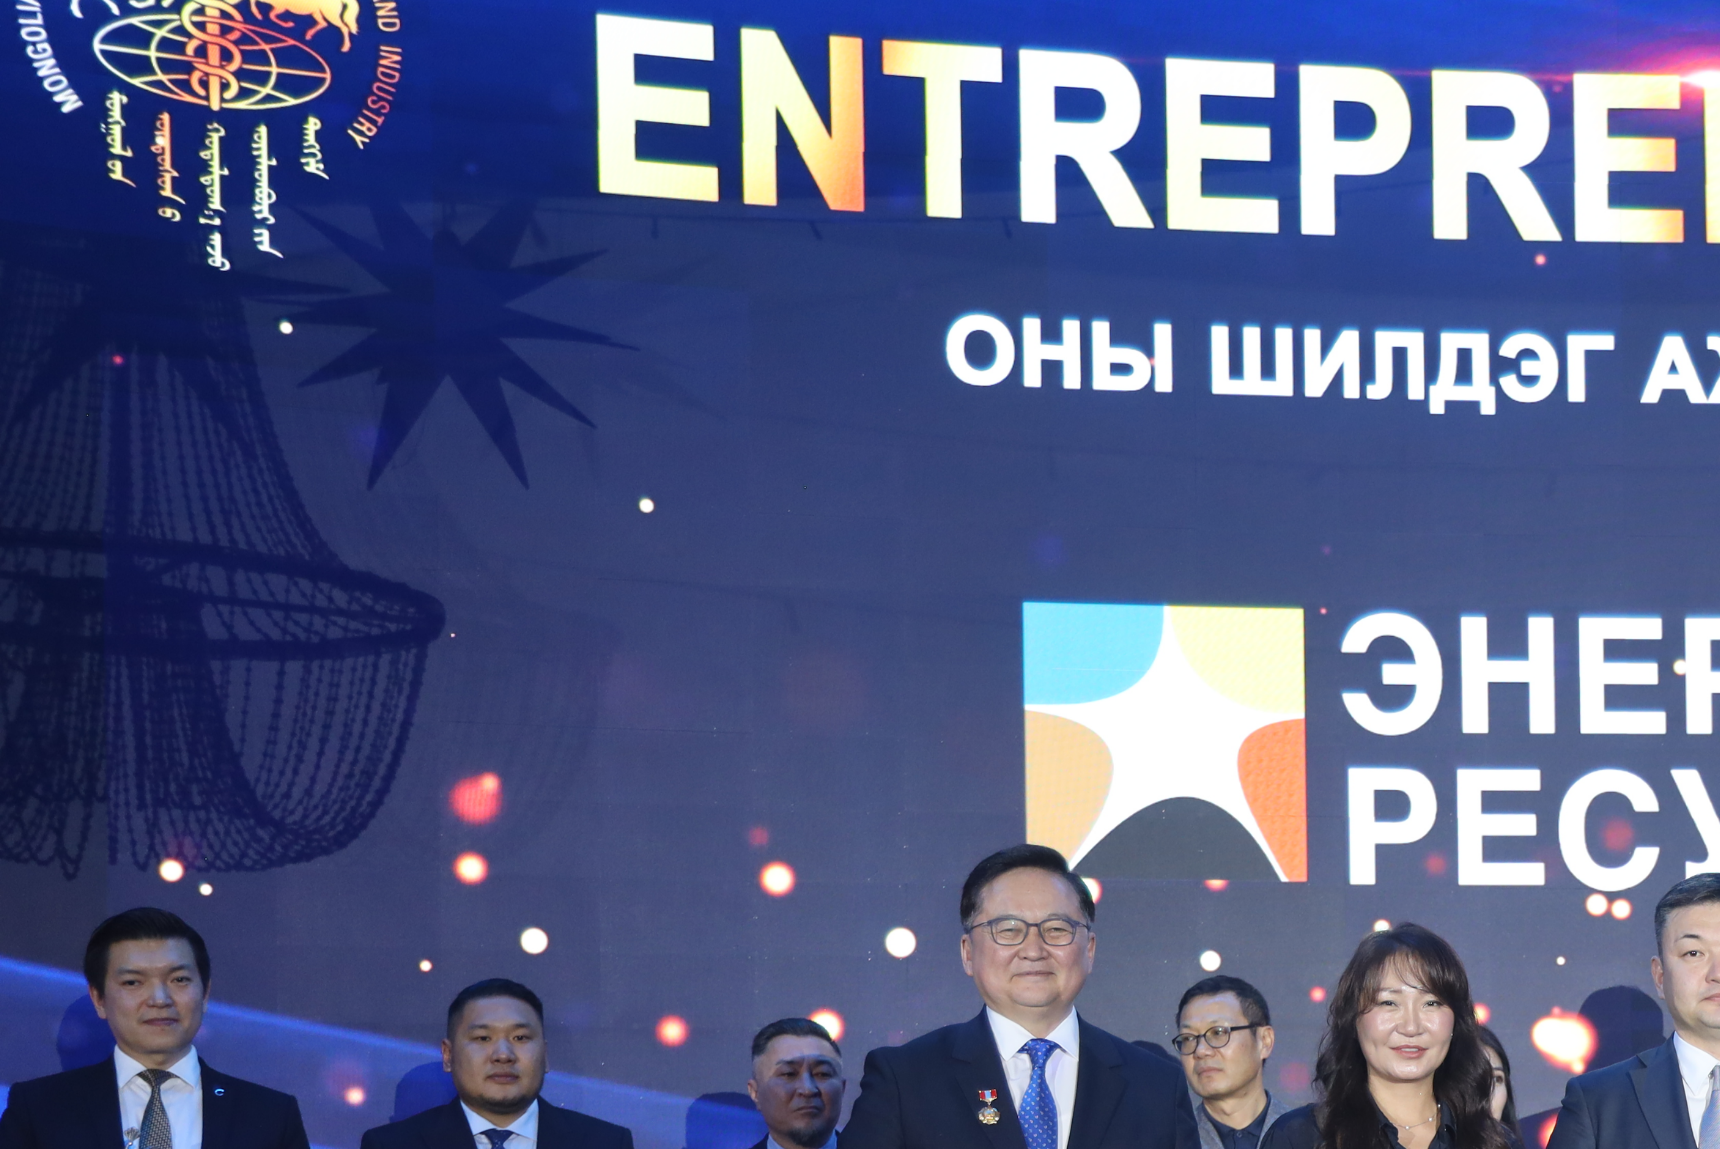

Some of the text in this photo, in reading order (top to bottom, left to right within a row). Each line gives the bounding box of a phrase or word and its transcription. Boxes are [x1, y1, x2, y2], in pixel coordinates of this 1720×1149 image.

[16, 0, 83, 113] MONGOLI
[347, 45, 402, 149] INDUSTRY
[946, 314, 1173, 393] ОНЫ
[1211, 325, 1615, 415] ШИЛДЭГ
